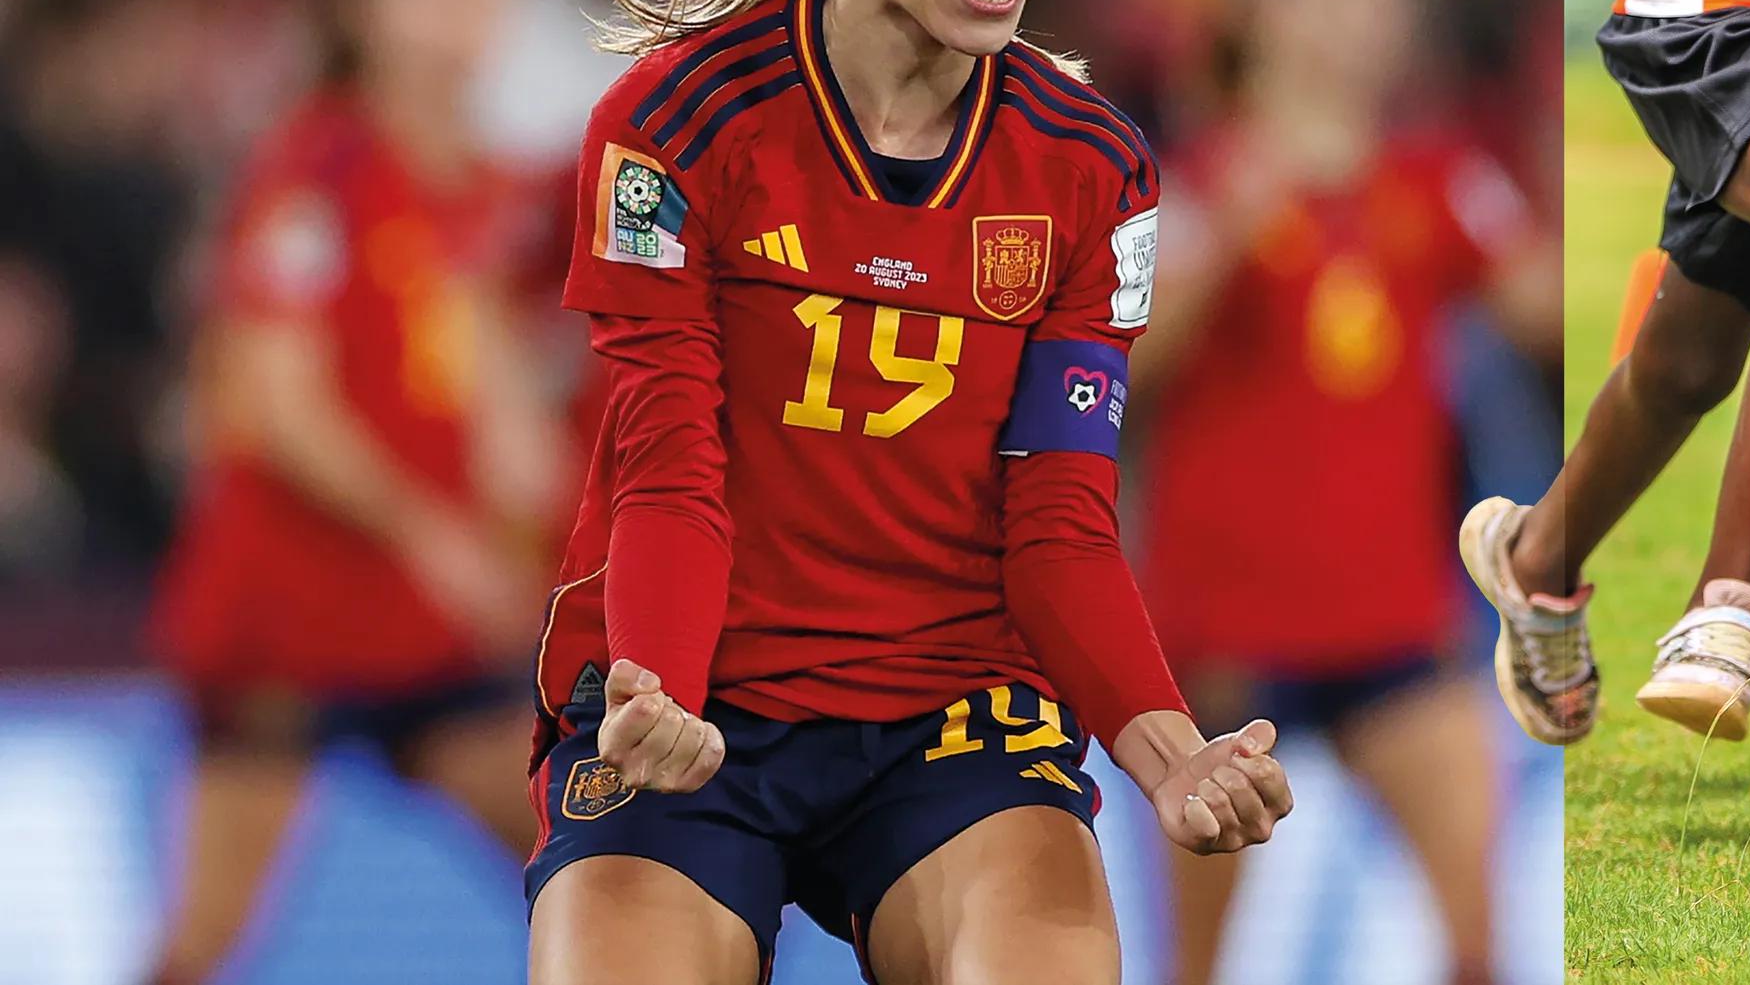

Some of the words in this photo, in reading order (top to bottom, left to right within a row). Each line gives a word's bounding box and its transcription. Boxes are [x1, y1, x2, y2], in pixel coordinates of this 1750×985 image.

[636, 233, 657, 245] 20
[872, 256, 913, 271] ENGLAND
[854, 263, 867, 274] 20
[868, 265, 903, 279] AUGUST
[904, 271, 928, 283] 2023
[873, 276, 907, 290] SYDNEY
[782, 293, 965, 439] 19
[925, 685, 1073, 762] 19
